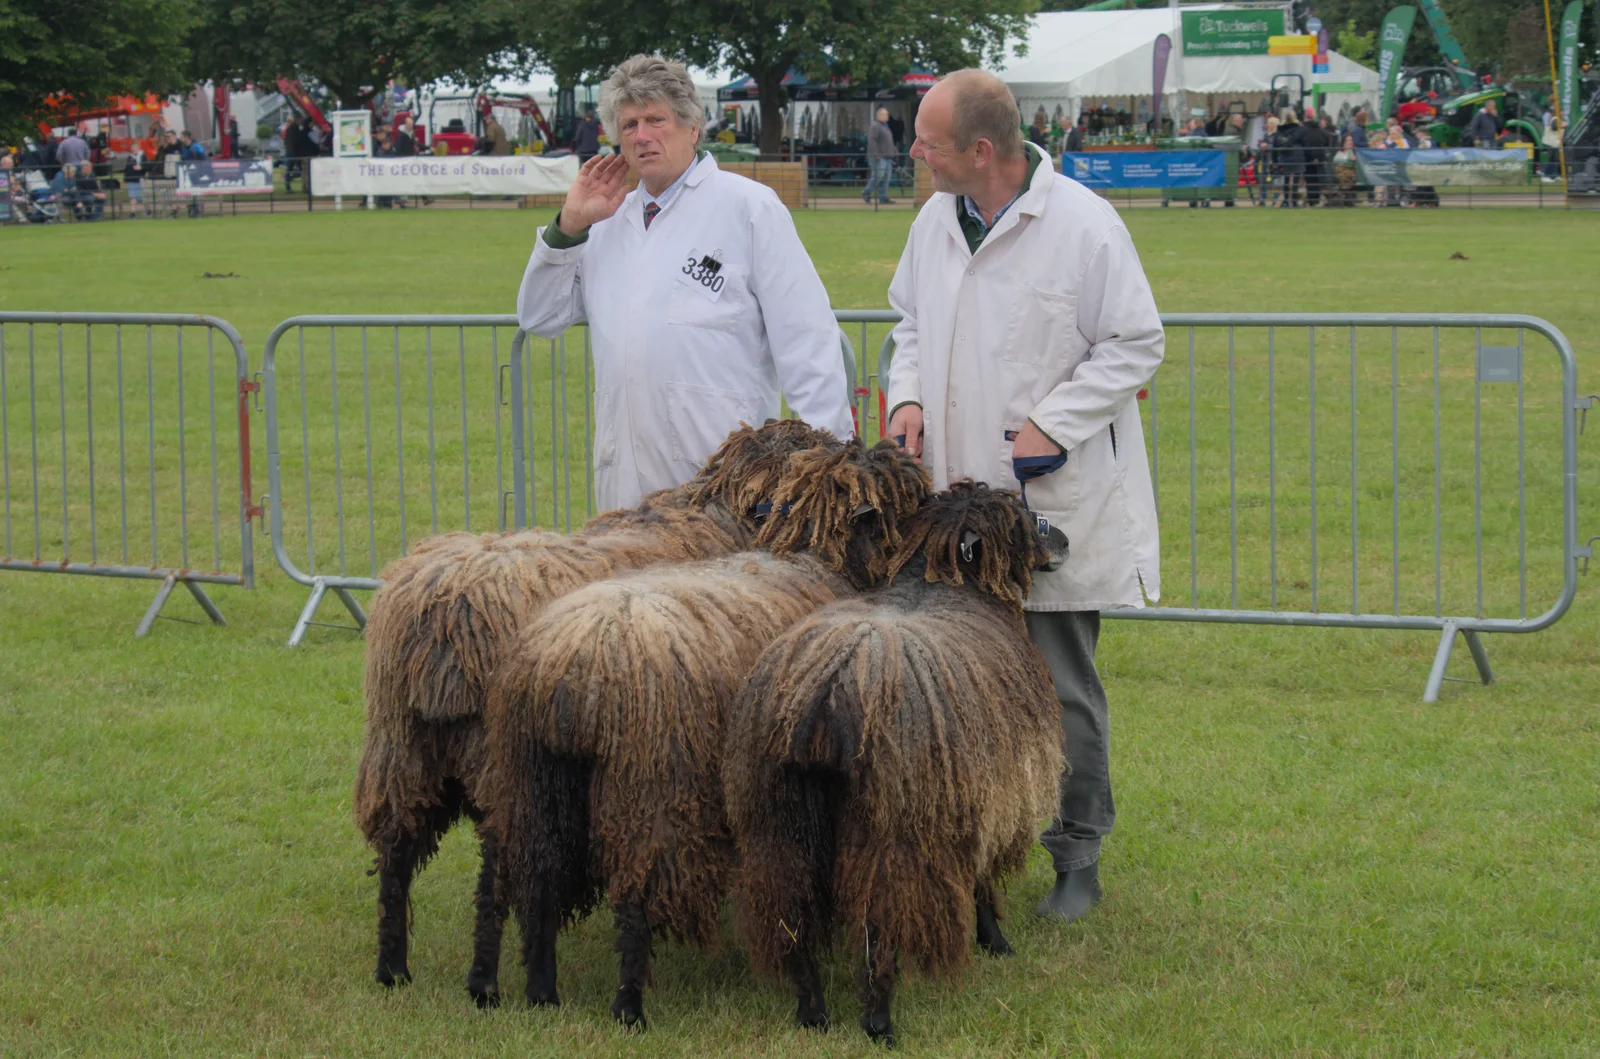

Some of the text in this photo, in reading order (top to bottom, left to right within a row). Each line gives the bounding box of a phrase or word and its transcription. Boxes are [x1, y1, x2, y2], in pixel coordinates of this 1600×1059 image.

[1215, 19, 1269, 33] Tuckwells
[358, 163, 385, 177] THE
[390, 163, 448, 177] GEORGE
[453, 163, 465, 176] of
[471, 163, 525, 176] Stamford
[682, 257, 725, 293] 3380
